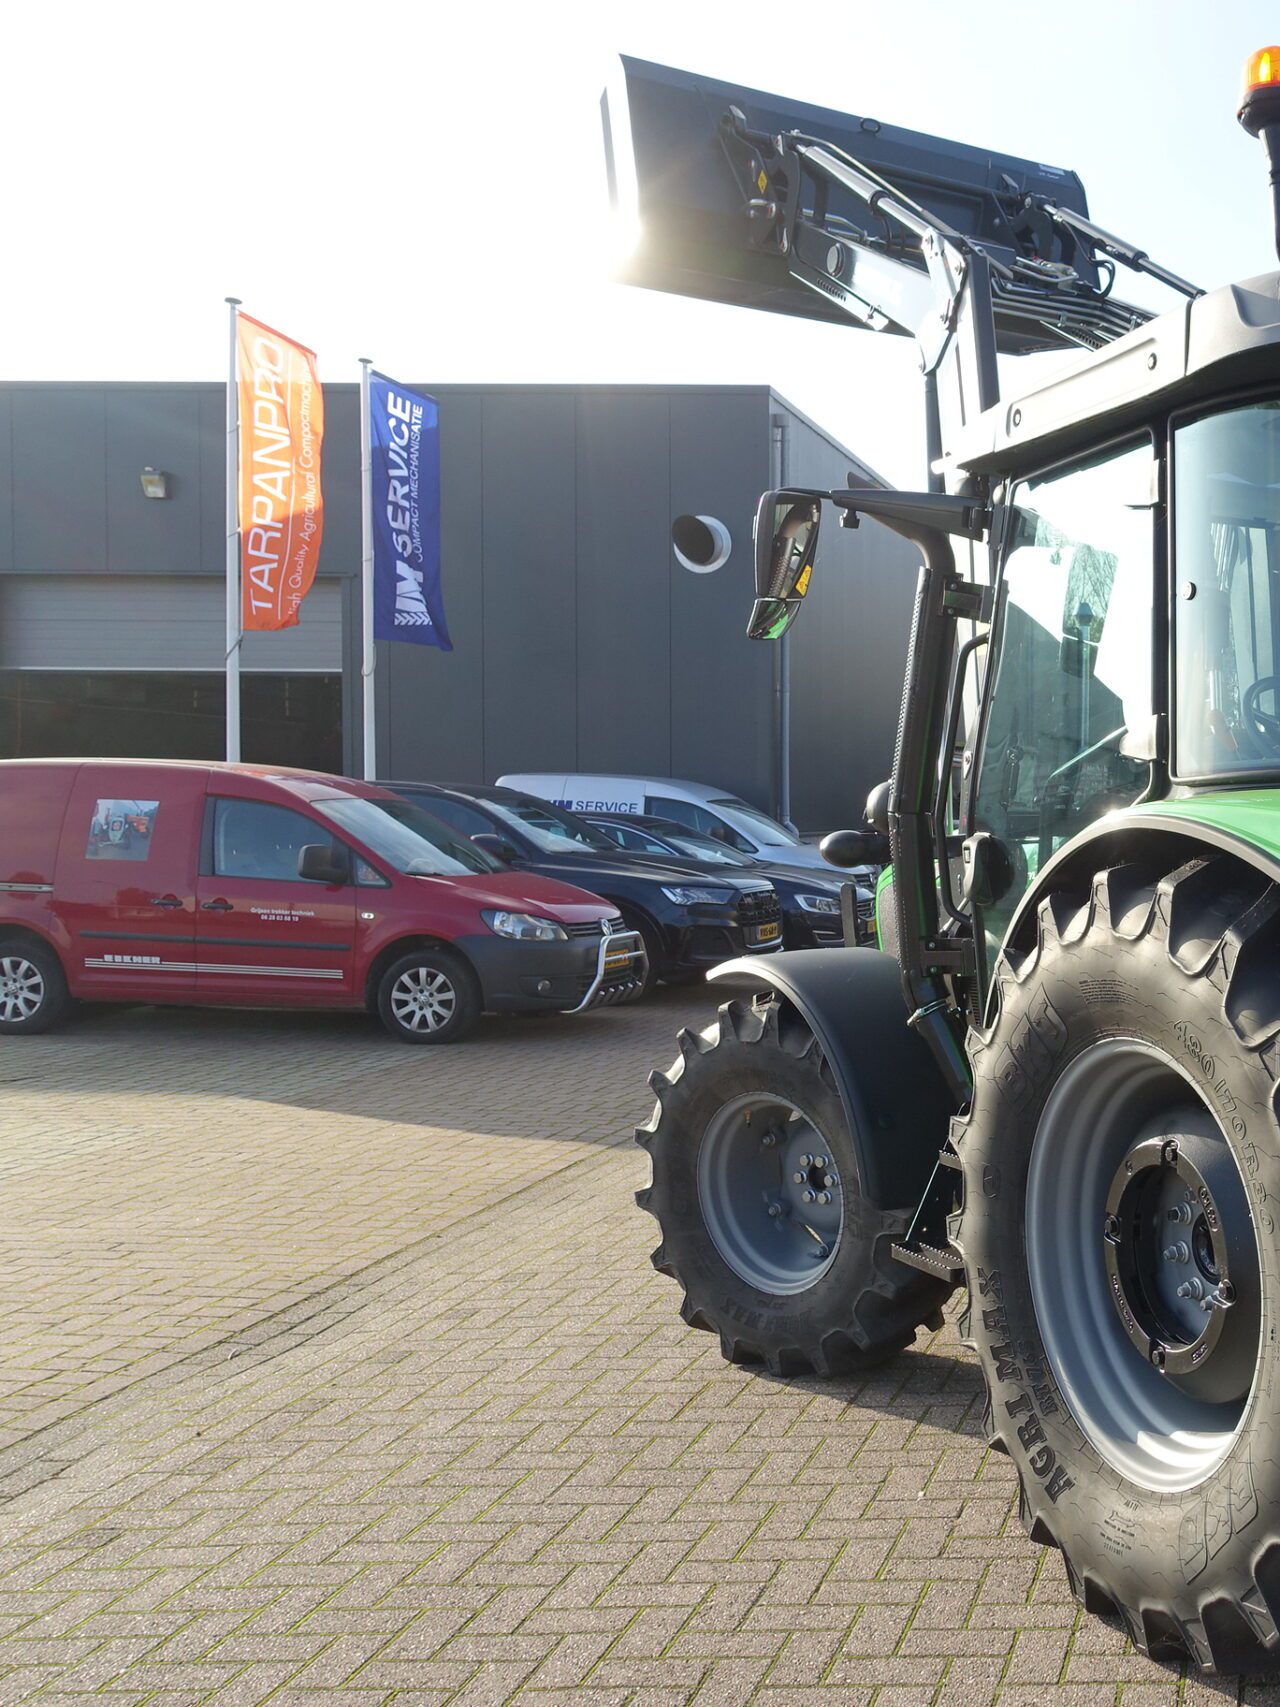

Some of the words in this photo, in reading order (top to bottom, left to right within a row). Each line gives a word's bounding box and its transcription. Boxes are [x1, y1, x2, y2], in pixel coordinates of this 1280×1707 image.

[247, 335, 291, 615] TARPANPRO
[387, 391, 413, 558] SERVICE
[411, 403, 424, 499] MECHANISATIE
[288, 543, 309, 594] Quality
[299, 469, 318, 541] Agricultural
[411, 500, 424, 562] COMPACT
[575, 800, 639, 814] SERVICE
[976, 1265, 1023, 1382] MAX
[1004, 1391, 1076, 1504] AGRI
